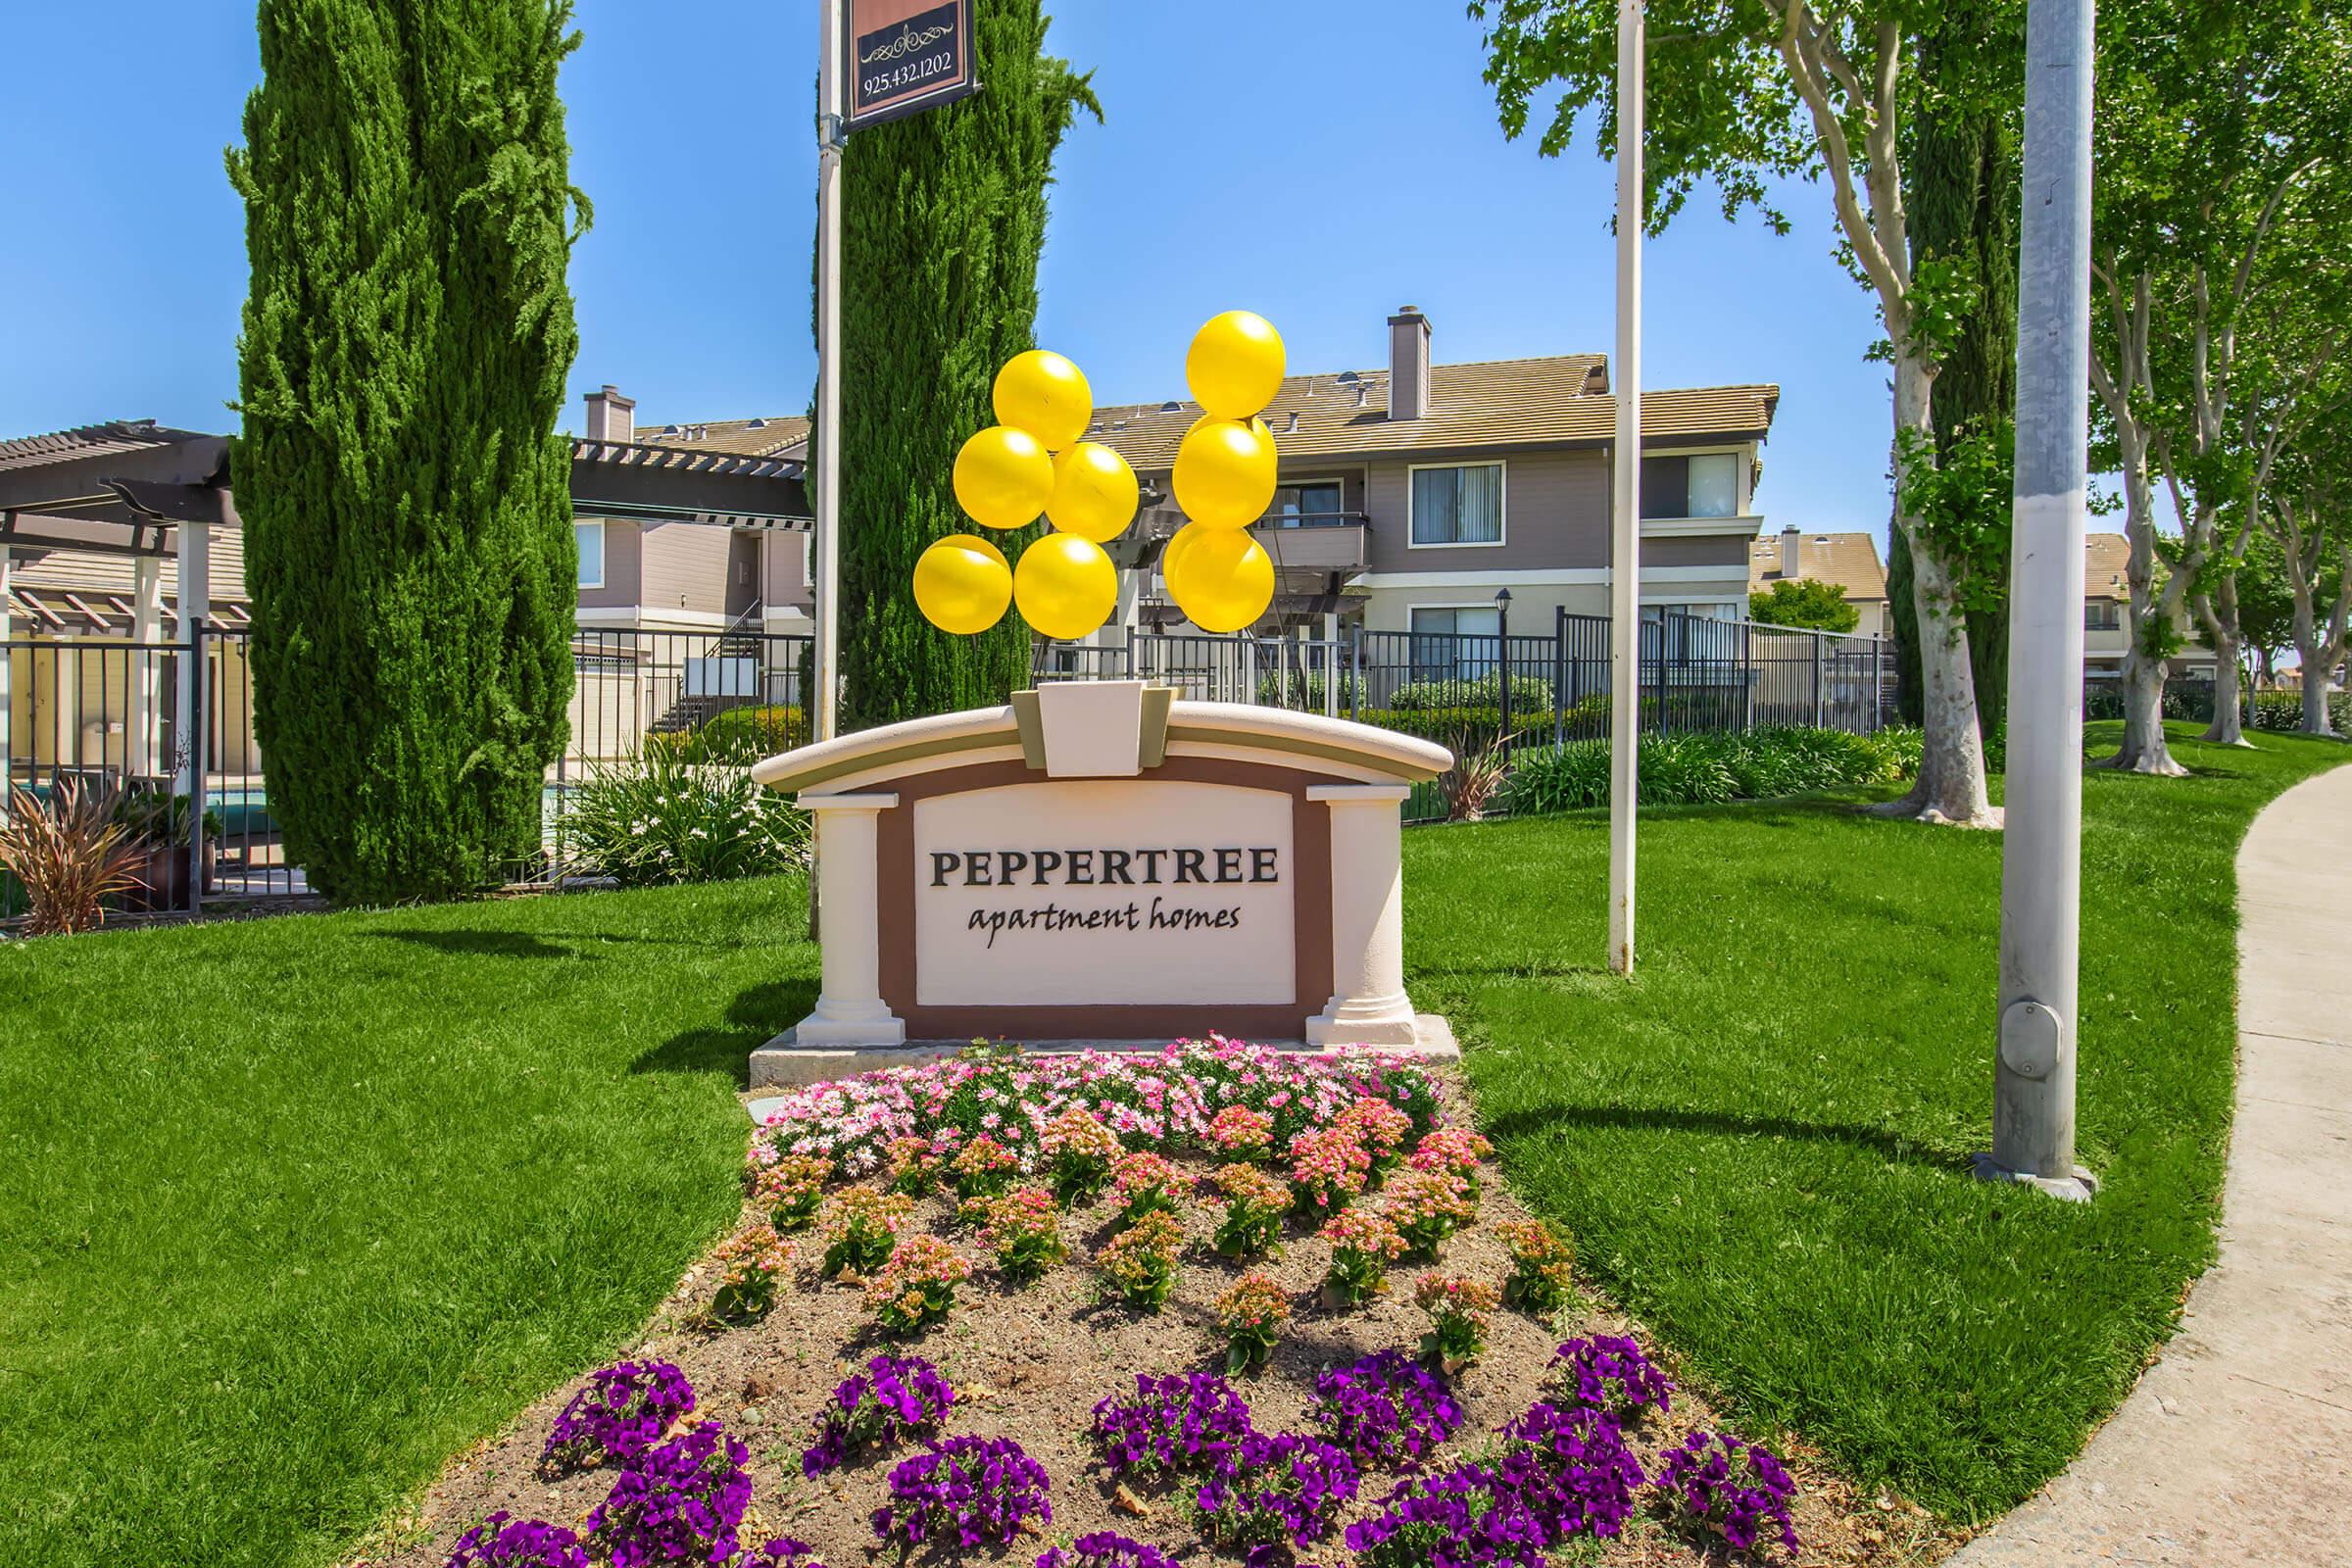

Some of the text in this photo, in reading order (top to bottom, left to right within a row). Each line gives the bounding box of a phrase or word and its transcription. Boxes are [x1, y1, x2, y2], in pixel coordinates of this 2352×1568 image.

[863, 52, 952, 97] 925.432.1202
[930, 848, 1279, 886] PEPPERTREE
[967, 897, 1242, 949] apartment homes
